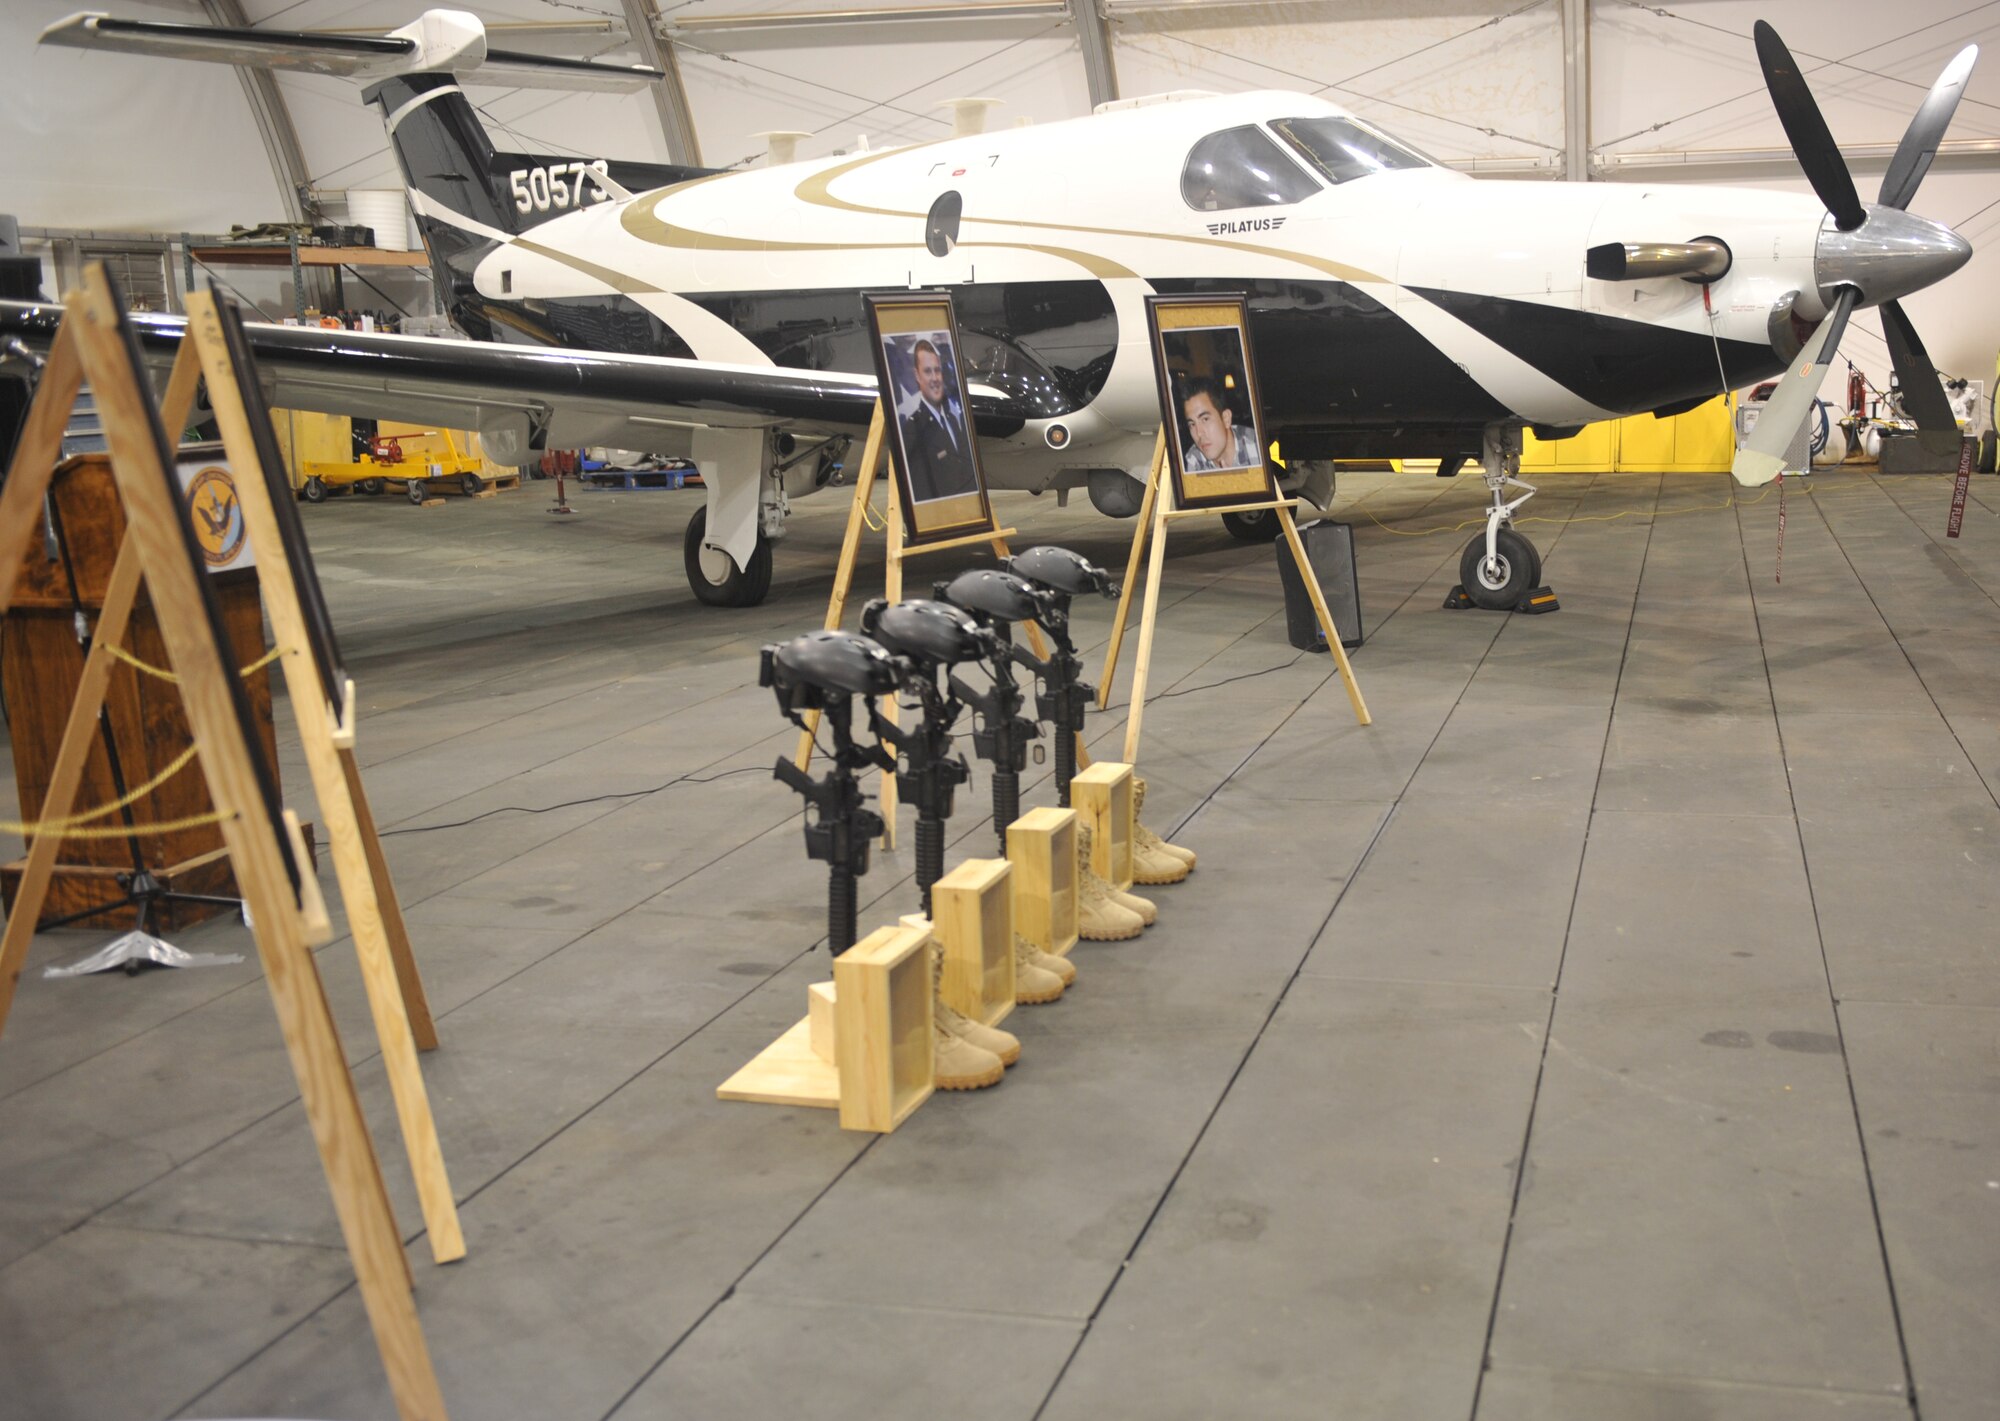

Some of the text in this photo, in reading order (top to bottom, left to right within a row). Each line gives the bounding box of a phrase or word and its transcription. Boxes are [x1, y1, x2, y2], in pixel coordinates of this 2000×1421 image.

[1220, 218, 1271, 235] PILATUS
[1949, 443, 1971, 534] REMOVE BEFORE FLIGHT
